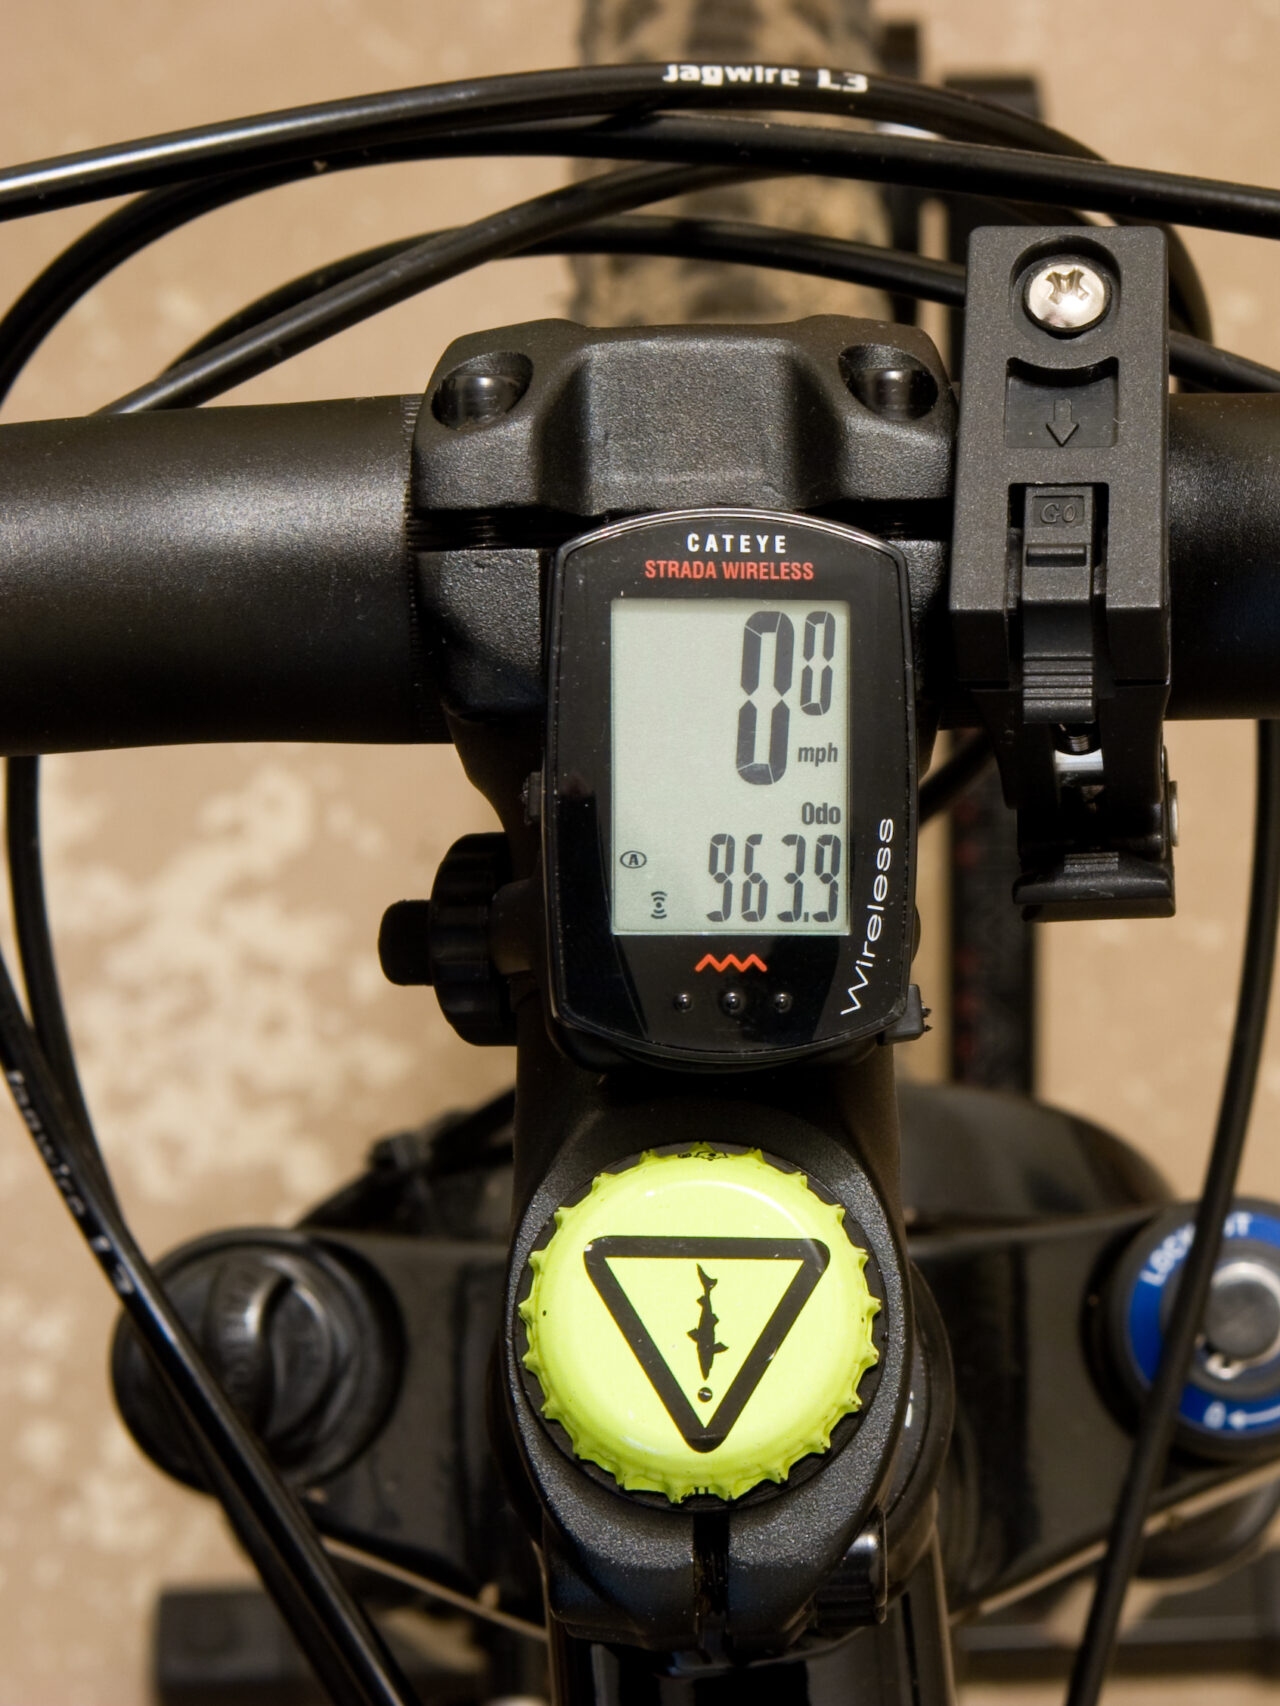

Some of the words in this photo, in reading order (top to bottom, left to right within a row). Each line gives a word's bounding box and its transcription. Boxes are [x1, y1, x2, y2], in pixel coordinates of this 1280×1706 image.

[817, 69, 869, 93] L3
[687, 533, 787, 554] CATEYE
[645, 560, 717, 579] STRADA
[722, 561, 815, 580] WIRELESS
[797, 742, 839, 768] mph
[801, 801, 842, 826] Odo
[705, 832, 843, 923] 963.9
[839, 817, 895, 1016] Wireless
